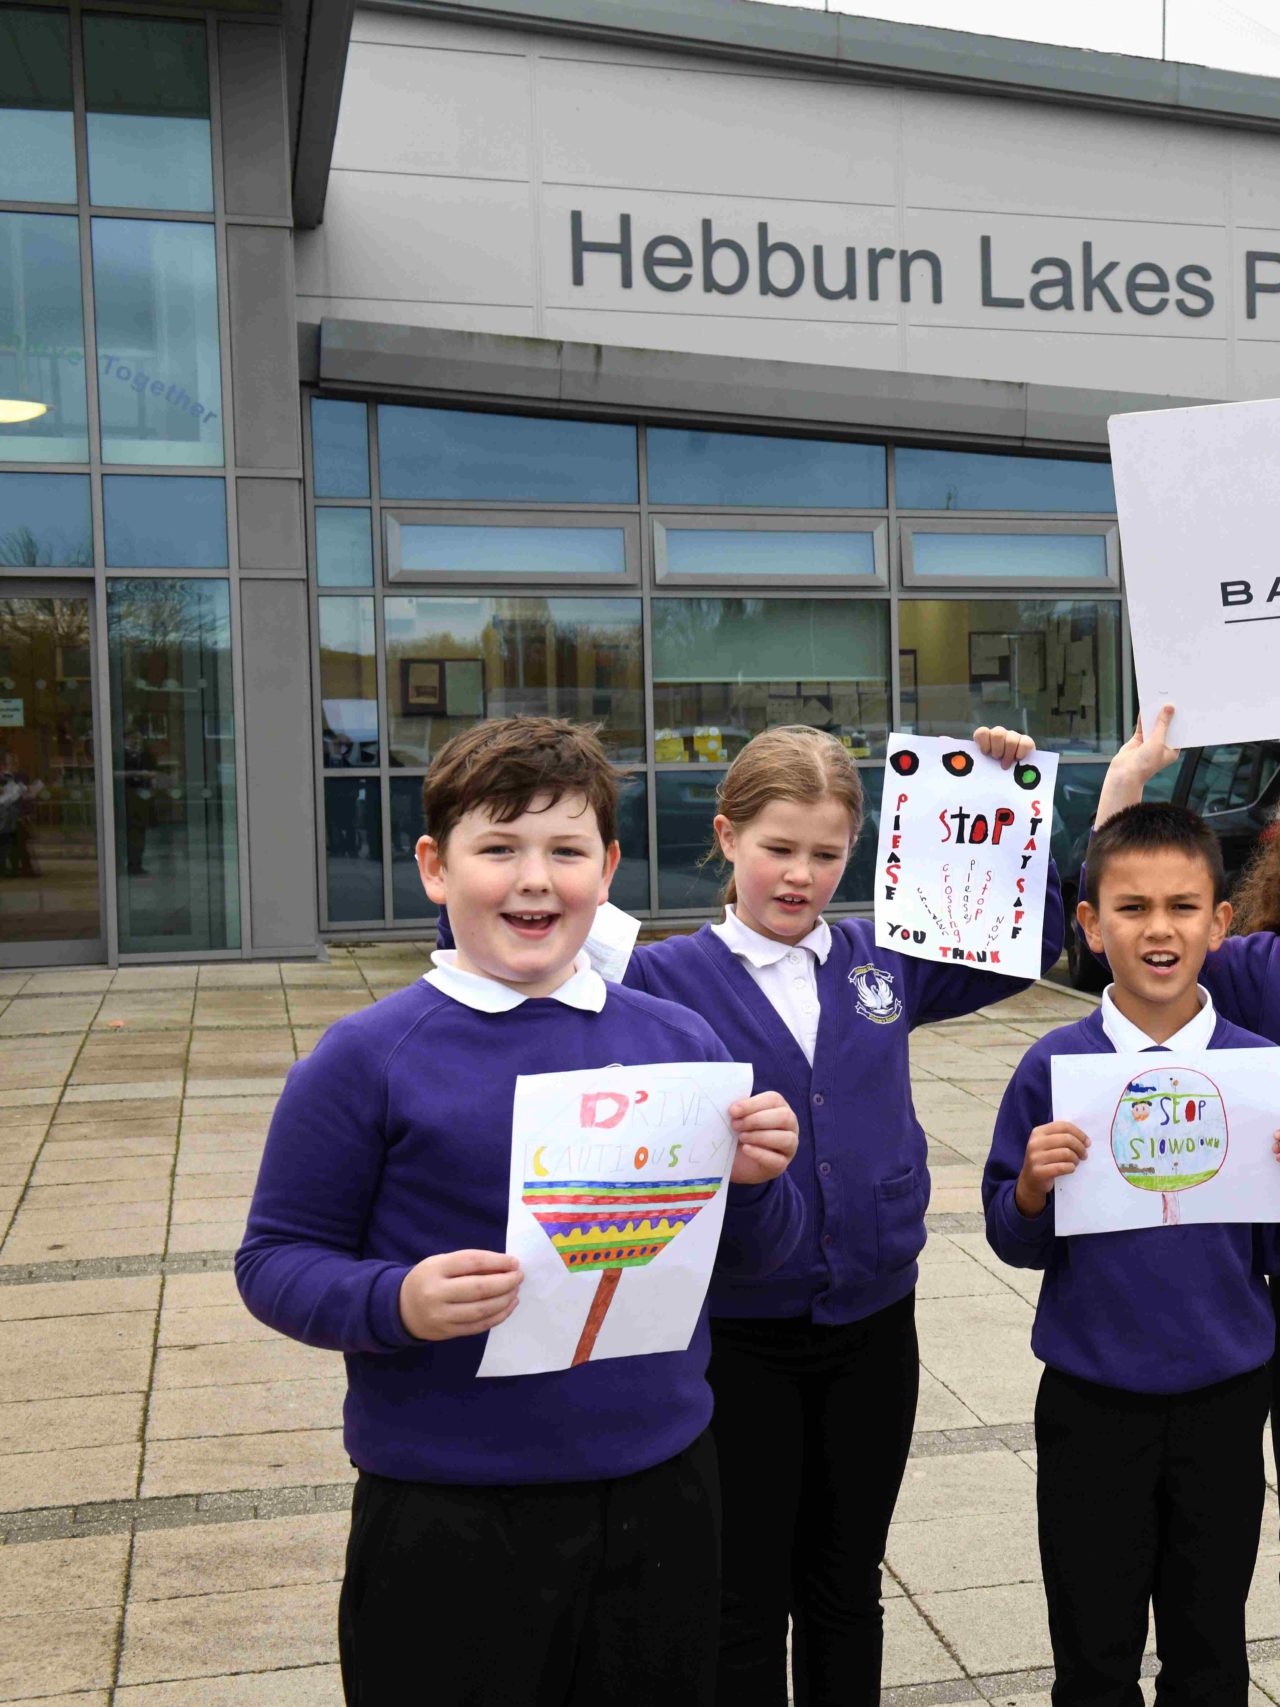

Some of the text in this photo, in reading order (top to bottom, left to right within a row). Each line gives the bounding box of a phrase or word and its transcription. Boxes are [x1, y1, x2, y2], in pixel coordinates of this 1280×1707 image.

[569, 210, 943, 305] Hebburn
[980, 234, 1215, 318] Lakes
[102, 354, 218, 424] Together
[886, 922, 927, 944] YOU
[939, 946, 1001, 964] THANK
